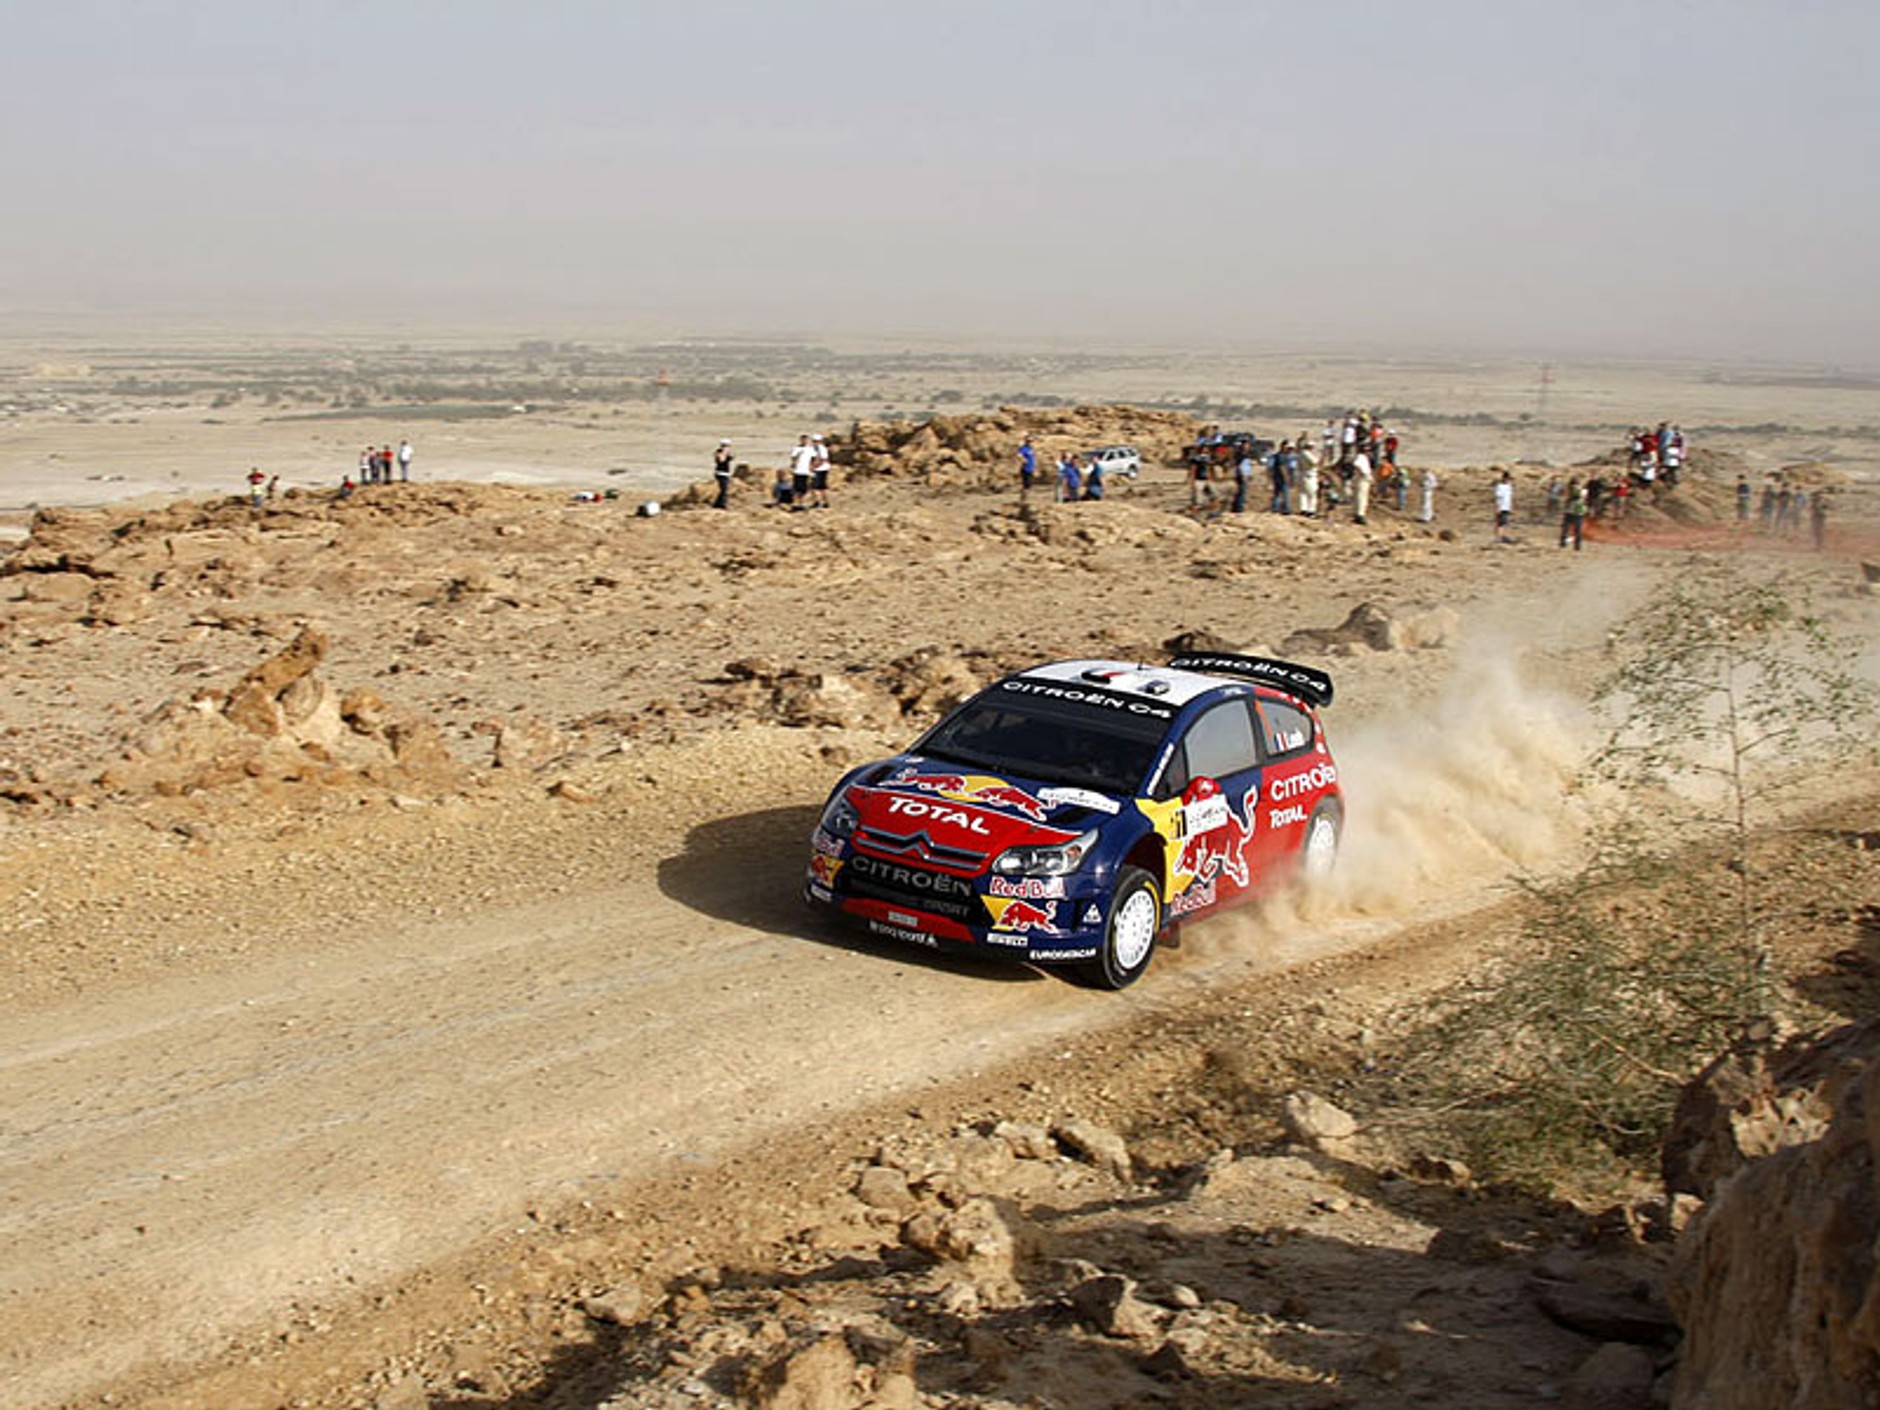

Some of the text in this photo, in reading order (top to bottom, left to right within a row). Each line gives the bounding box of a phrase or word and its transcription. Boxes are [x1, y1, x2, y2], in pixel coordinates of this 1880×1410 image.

[888, 796, 990, 835] TOTAL
[1269, 804, 1308, 828] TOTAL
[852, 855, 972, 896] CITROËN
[990, 876, 1028, 897] Red
